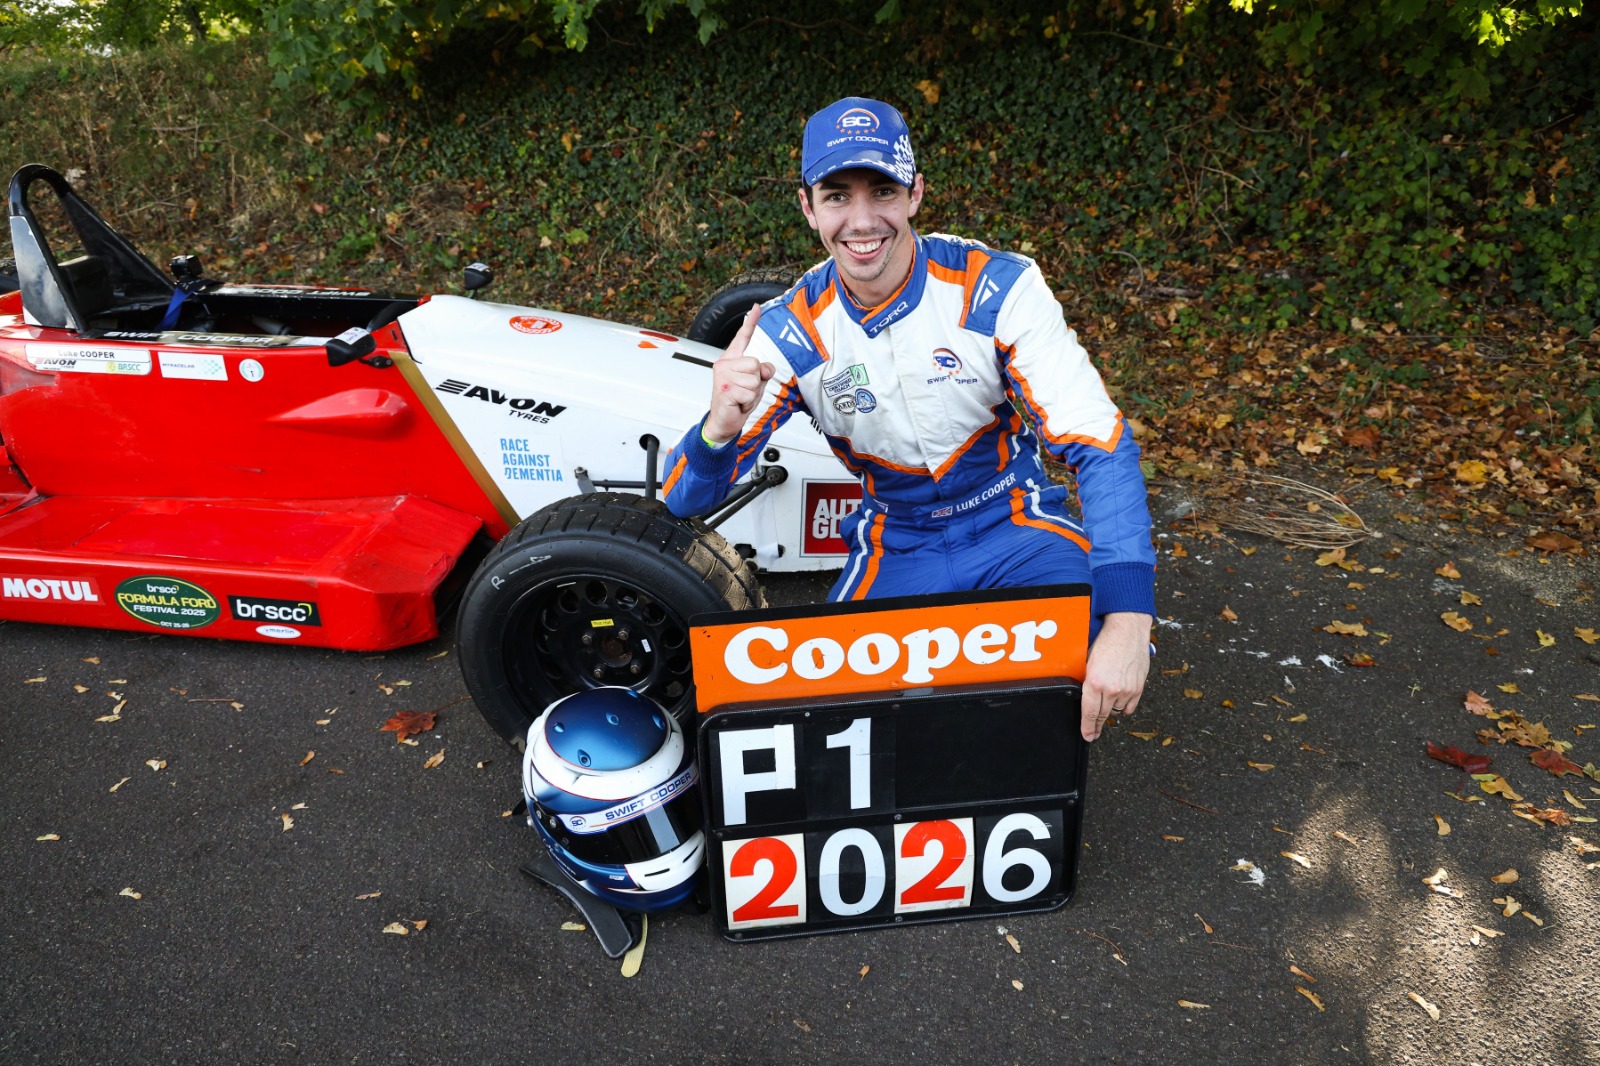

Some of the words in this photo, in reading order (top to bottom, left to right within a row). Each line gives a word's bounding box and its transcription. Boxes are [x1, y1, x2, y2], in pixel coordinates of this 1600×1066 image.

[842, 116, 872, 128] SC
[826, 136, 854, 148] SWIFT
[855, 135, 889, 146] COOPER
[869, 301, 909, 334] TORQ
[103, 331, 176, 340] SWIFT
[177, 333, 274, 344] COOPER
[79, 350, 115, 359] COOPER
[43, 358, 77, 367] AVON
[117, 362, 141, 372] BRSCC
[464, 385, 567, 418] AVON
[508, 409, 551, 425] TYRES
[499, 437, 530, 452] RACE
[502, 453, 550, 468] AGAINST
[503, 467, 563, 483] DEMENTIA
[956, 493, 982, 512] LUKE
[981, 472, 1017, 501] COOPER
[2, 576, 99, 602] MOTUL
[146, 583, 178, 595] brscc
[117, 592, 181, 607] FORMULA
[180, 596, 217, 609] FORD
[133, 604, 180, 615] FESTIVAL
[180, 607, 207, 617] 2025
[236, 598, 308, 622] brscc
[160, 620, 173, 628] OCT
[723, 618, 1058, 685] Cooper
[604, 799, 646, 821] SWIFT
[649, 771, 692, 802] COOPER
[728, 812, 1053, 923] 2026
